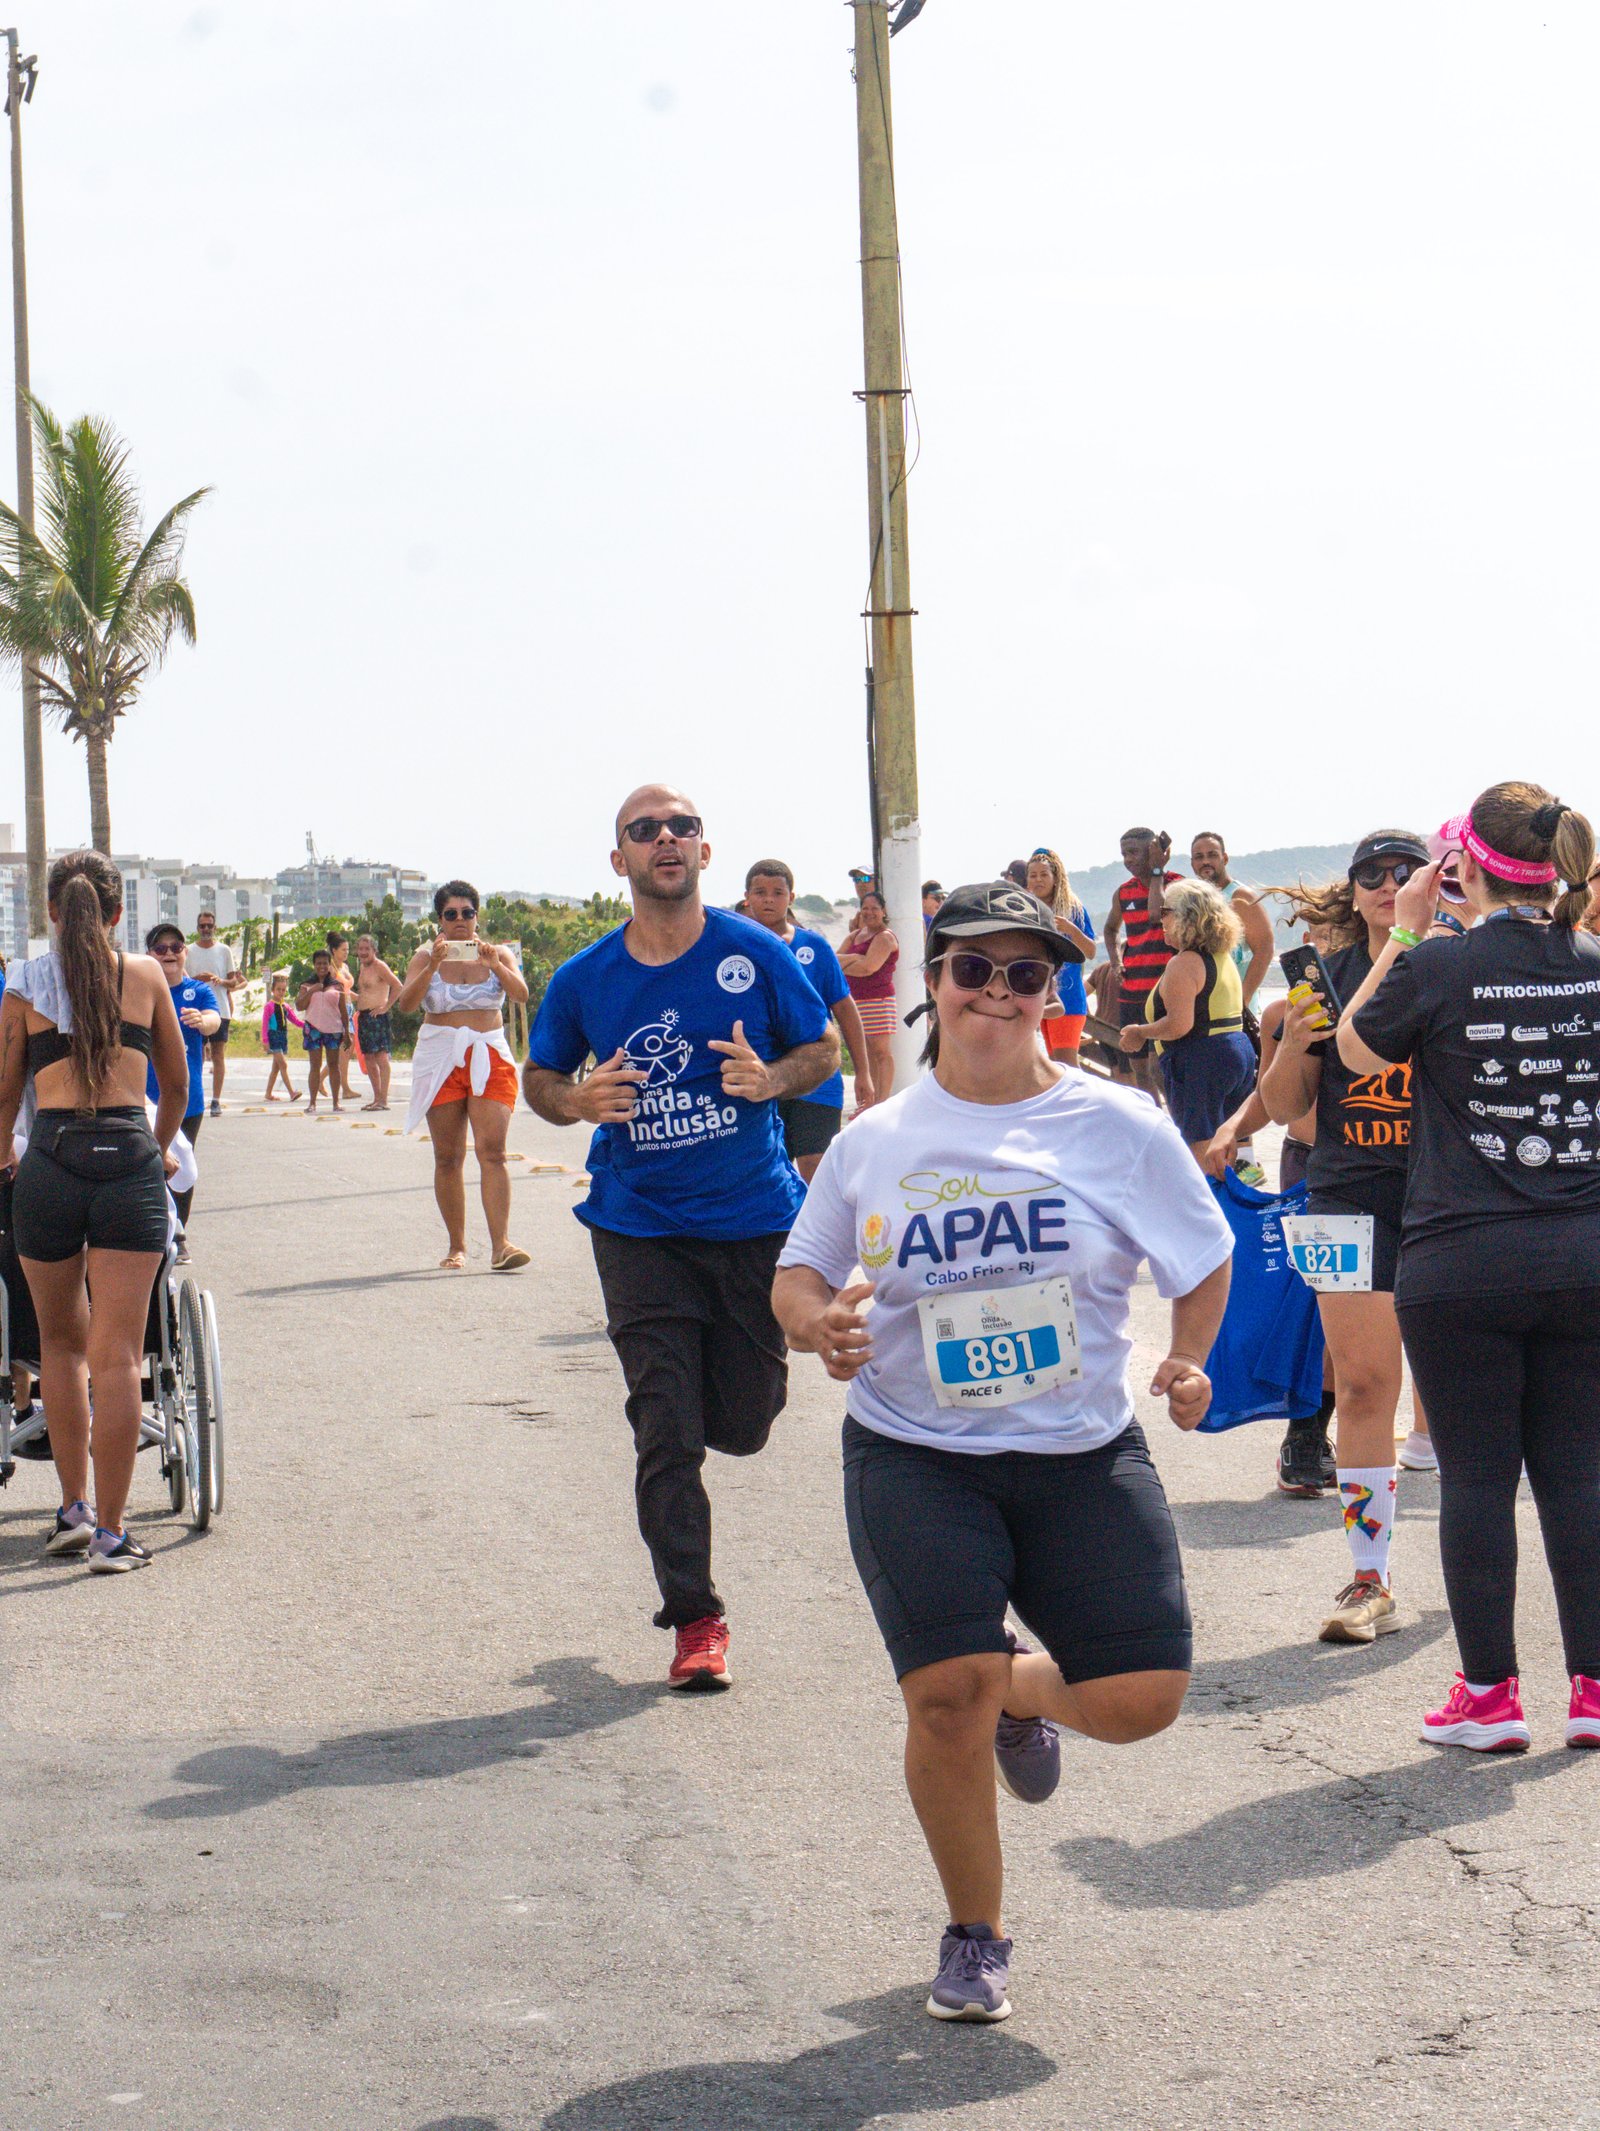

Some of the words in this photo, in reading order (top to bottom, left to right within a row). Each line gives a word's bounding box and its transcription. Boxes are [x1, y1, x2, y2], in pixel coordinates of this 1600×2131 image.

[1469, 1025, 1502, 1035] novolare
[1473, 1074, 1484, 1082] LA
[1485, 1076, 1508, 1084] MART
[696, 1094, 711, 1106] de
[635, 1141, 660, 1151] Juntos
[660, 1142, 671, 1150] no
[898, 1198, 1070, 1268] APAE
[1304, 1245, 1342, 1272] 821
[925, 1270, 968, 1286] Cabo
[972, 1265, 1004, 1279] Frio
[964, 1331, 1036, 1379] 891
[960, 1386, 992, 1397] PACE
[994, 1384, 1003, 1394] 6
